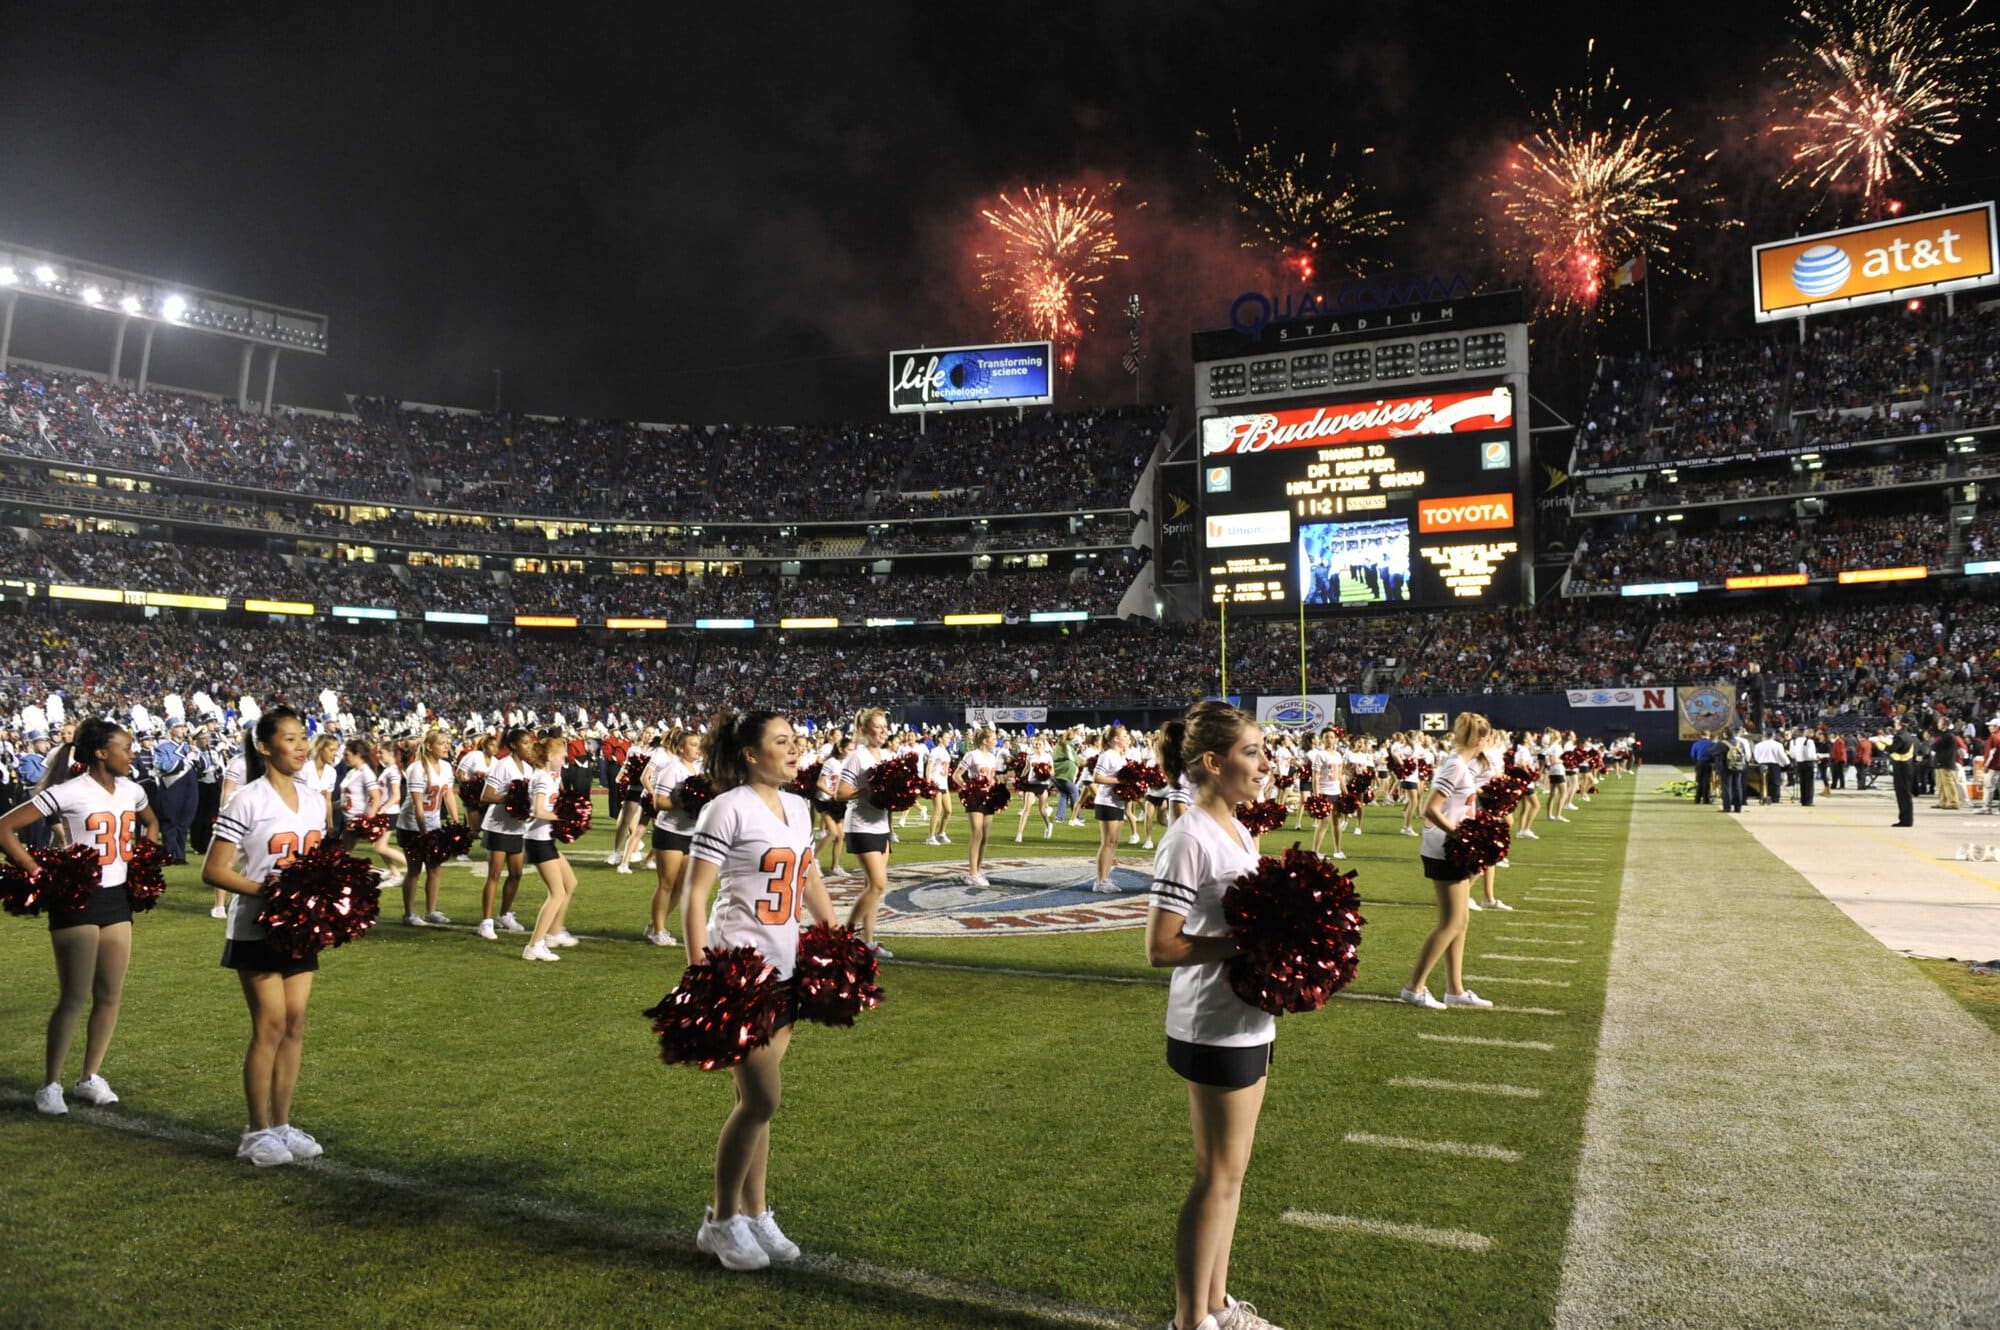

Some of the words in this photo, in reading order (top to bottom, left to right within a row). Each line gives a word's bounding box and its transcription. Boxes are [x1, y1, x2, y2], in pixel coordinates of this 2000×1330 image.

[1862, 229, 1961, 277] at&t
[1280, 307, 1453, 340] STADIUM
[978, 356, 1043, 370] Transforming
[992, 366, 1028, 376] science
[894, 356, 946, 401] life
[931, 386, 990, 398] technologies
[1232, 398, 1433, 453] Budweiser
[1368, 444, 1385, 458] TO
[1307, 464, 1331, 479] DR
[1335, 457, 1396, 476] PEPPER
[1286, 475, 1371, 496] HALFTIME
[1379, 470, 1425, 489] SHOW
[1423, 503, 1509, 525] TOYOTA
[1162, 523, 1193, 536] Sprint
[1643, 689, 1665, 709] N
[975, 709, 989, 726] A
[1423, 713, 1446, 731] 25
